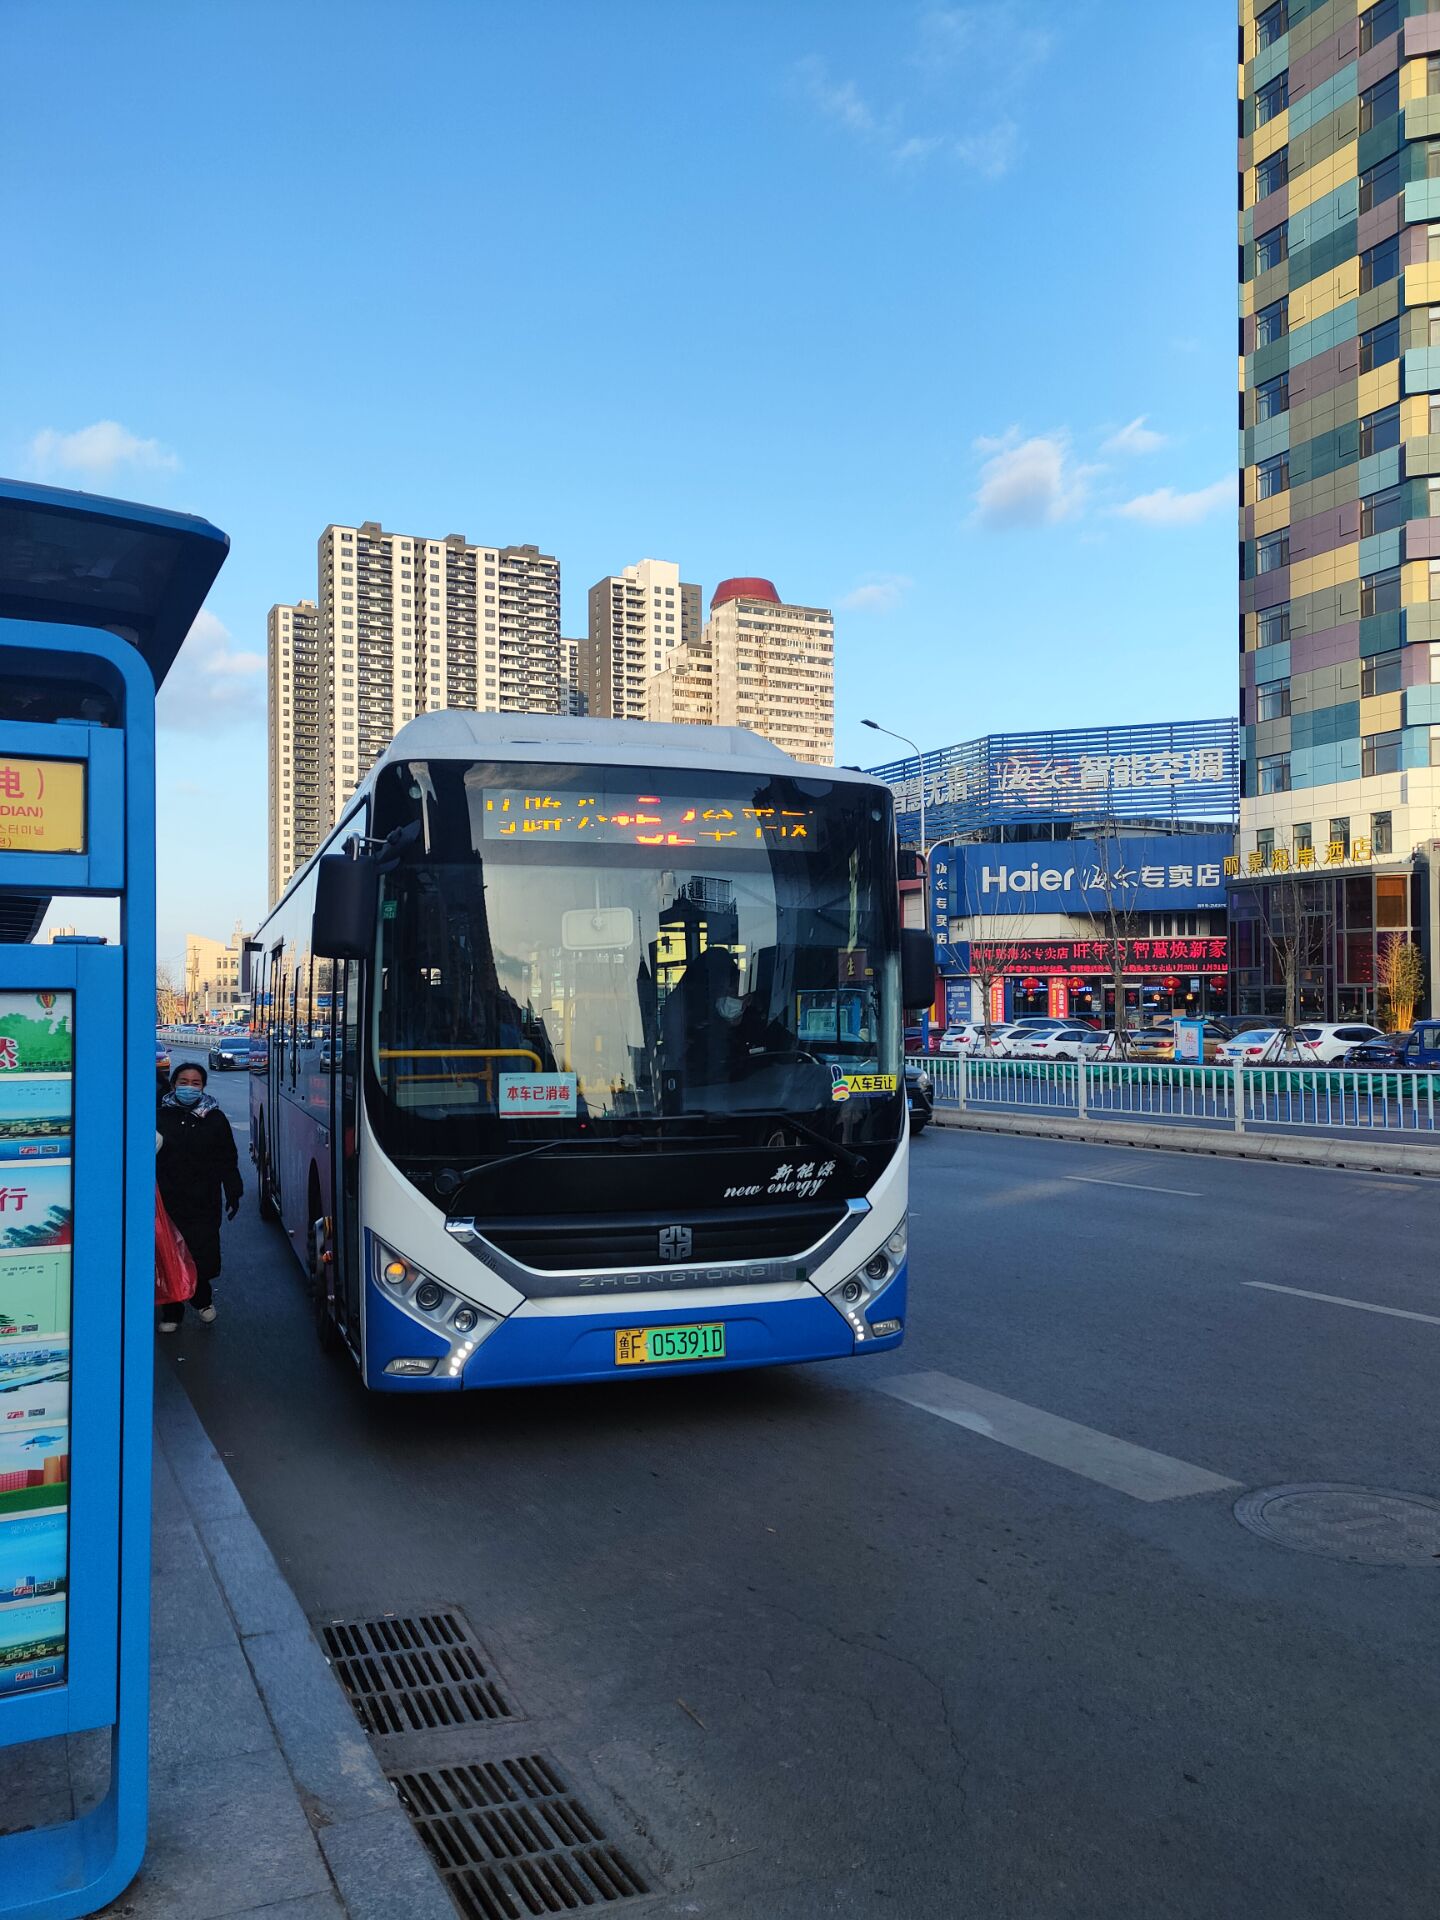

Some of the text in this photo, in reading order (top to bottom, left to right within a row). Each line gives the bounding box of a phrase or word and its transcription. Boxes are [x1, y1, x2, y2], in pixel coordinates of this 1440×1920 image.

[996, 747, 1224, 792] 海尔智能空调
[1223, 837, 1373, 877] 丽景海岸酒店
[982, 862, 1221, 893] Haier 海尔专卖店
[935, 862, 948, 945] 海尔专卖店
[1133, 940, 1227, 960] 智慧焕新家
[507, 1085, 570, 1101] 本车已消毒
[850, 1076, 893, 1090] 人车互让
[770, 1159, 836, 1182] 新能源
[723, 1178, 826, 1198] new energy
[579, 1266, 766, 1287] ZHONGTONG
[653, 1329, 723, 1357] 05391D
